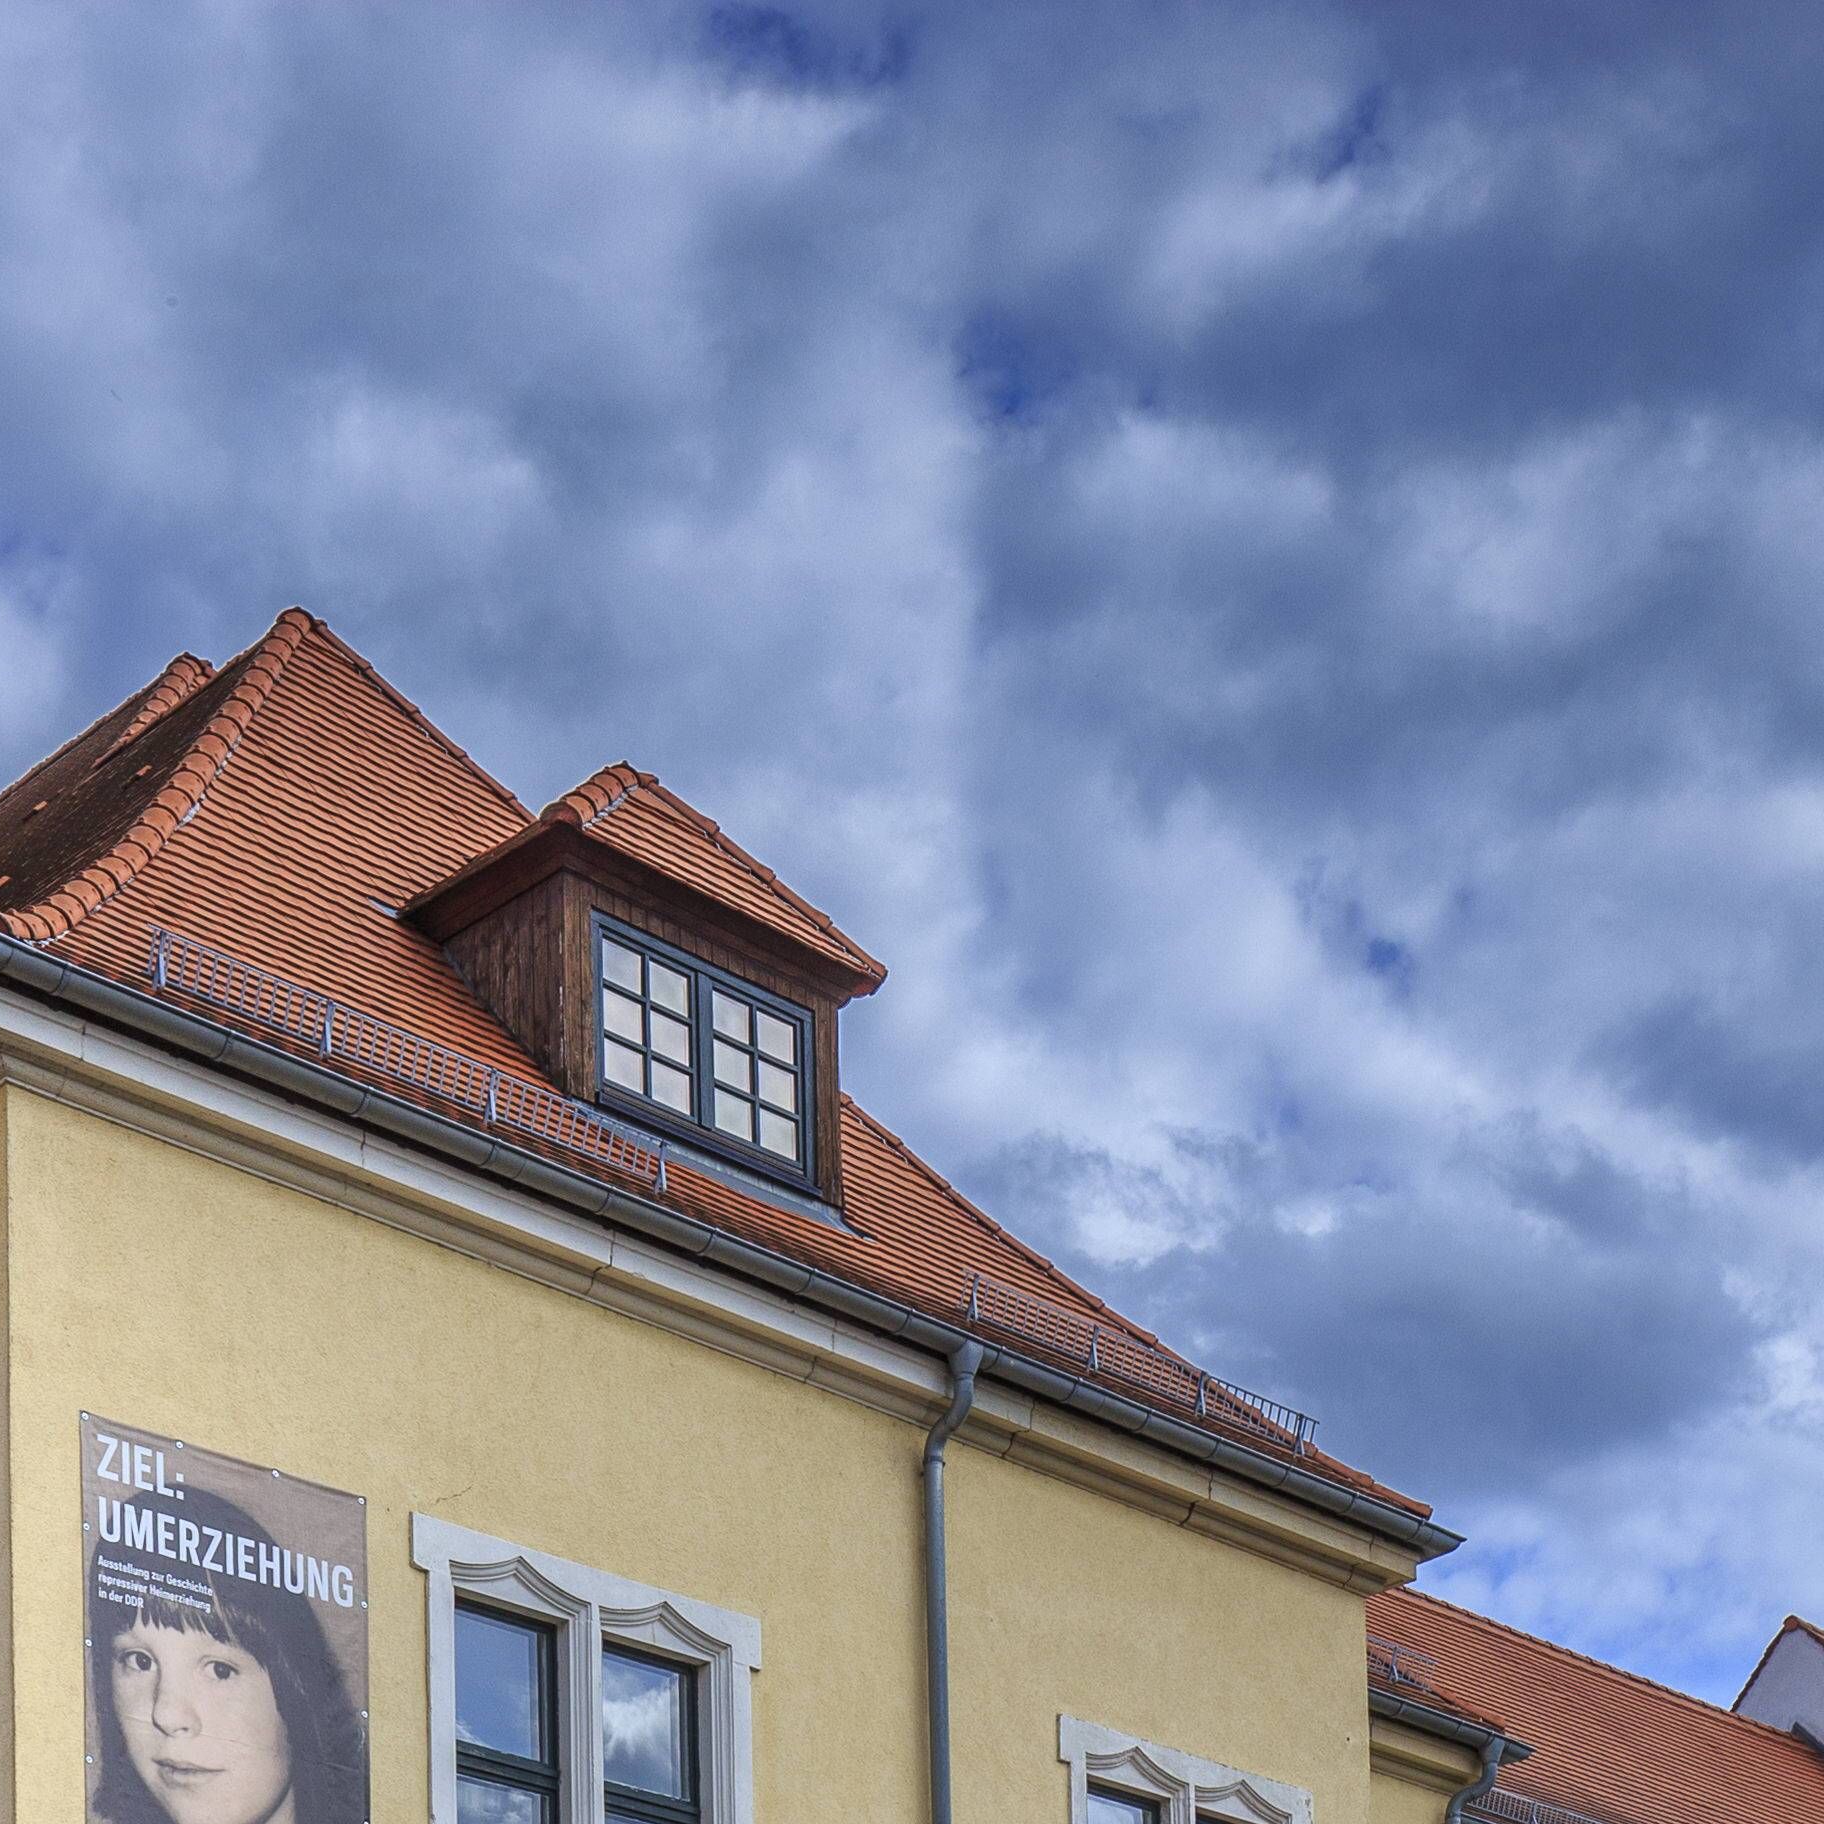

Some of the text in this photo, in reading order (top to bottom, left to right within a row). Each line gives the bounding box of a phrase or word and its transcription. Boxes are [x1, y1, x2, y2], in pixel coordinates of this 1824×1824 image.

[97, 1434, 184, 1500] ZIEL:
[98, 1496, 353, 1608] UMERZIEHUNG
[97, 1555, 214, 1597] Ausstellung zur Geschichte
[98, 1573, 211, 1614] repressiver Heimerziehung
[98, 1587, 144, 1609] in der DDR
